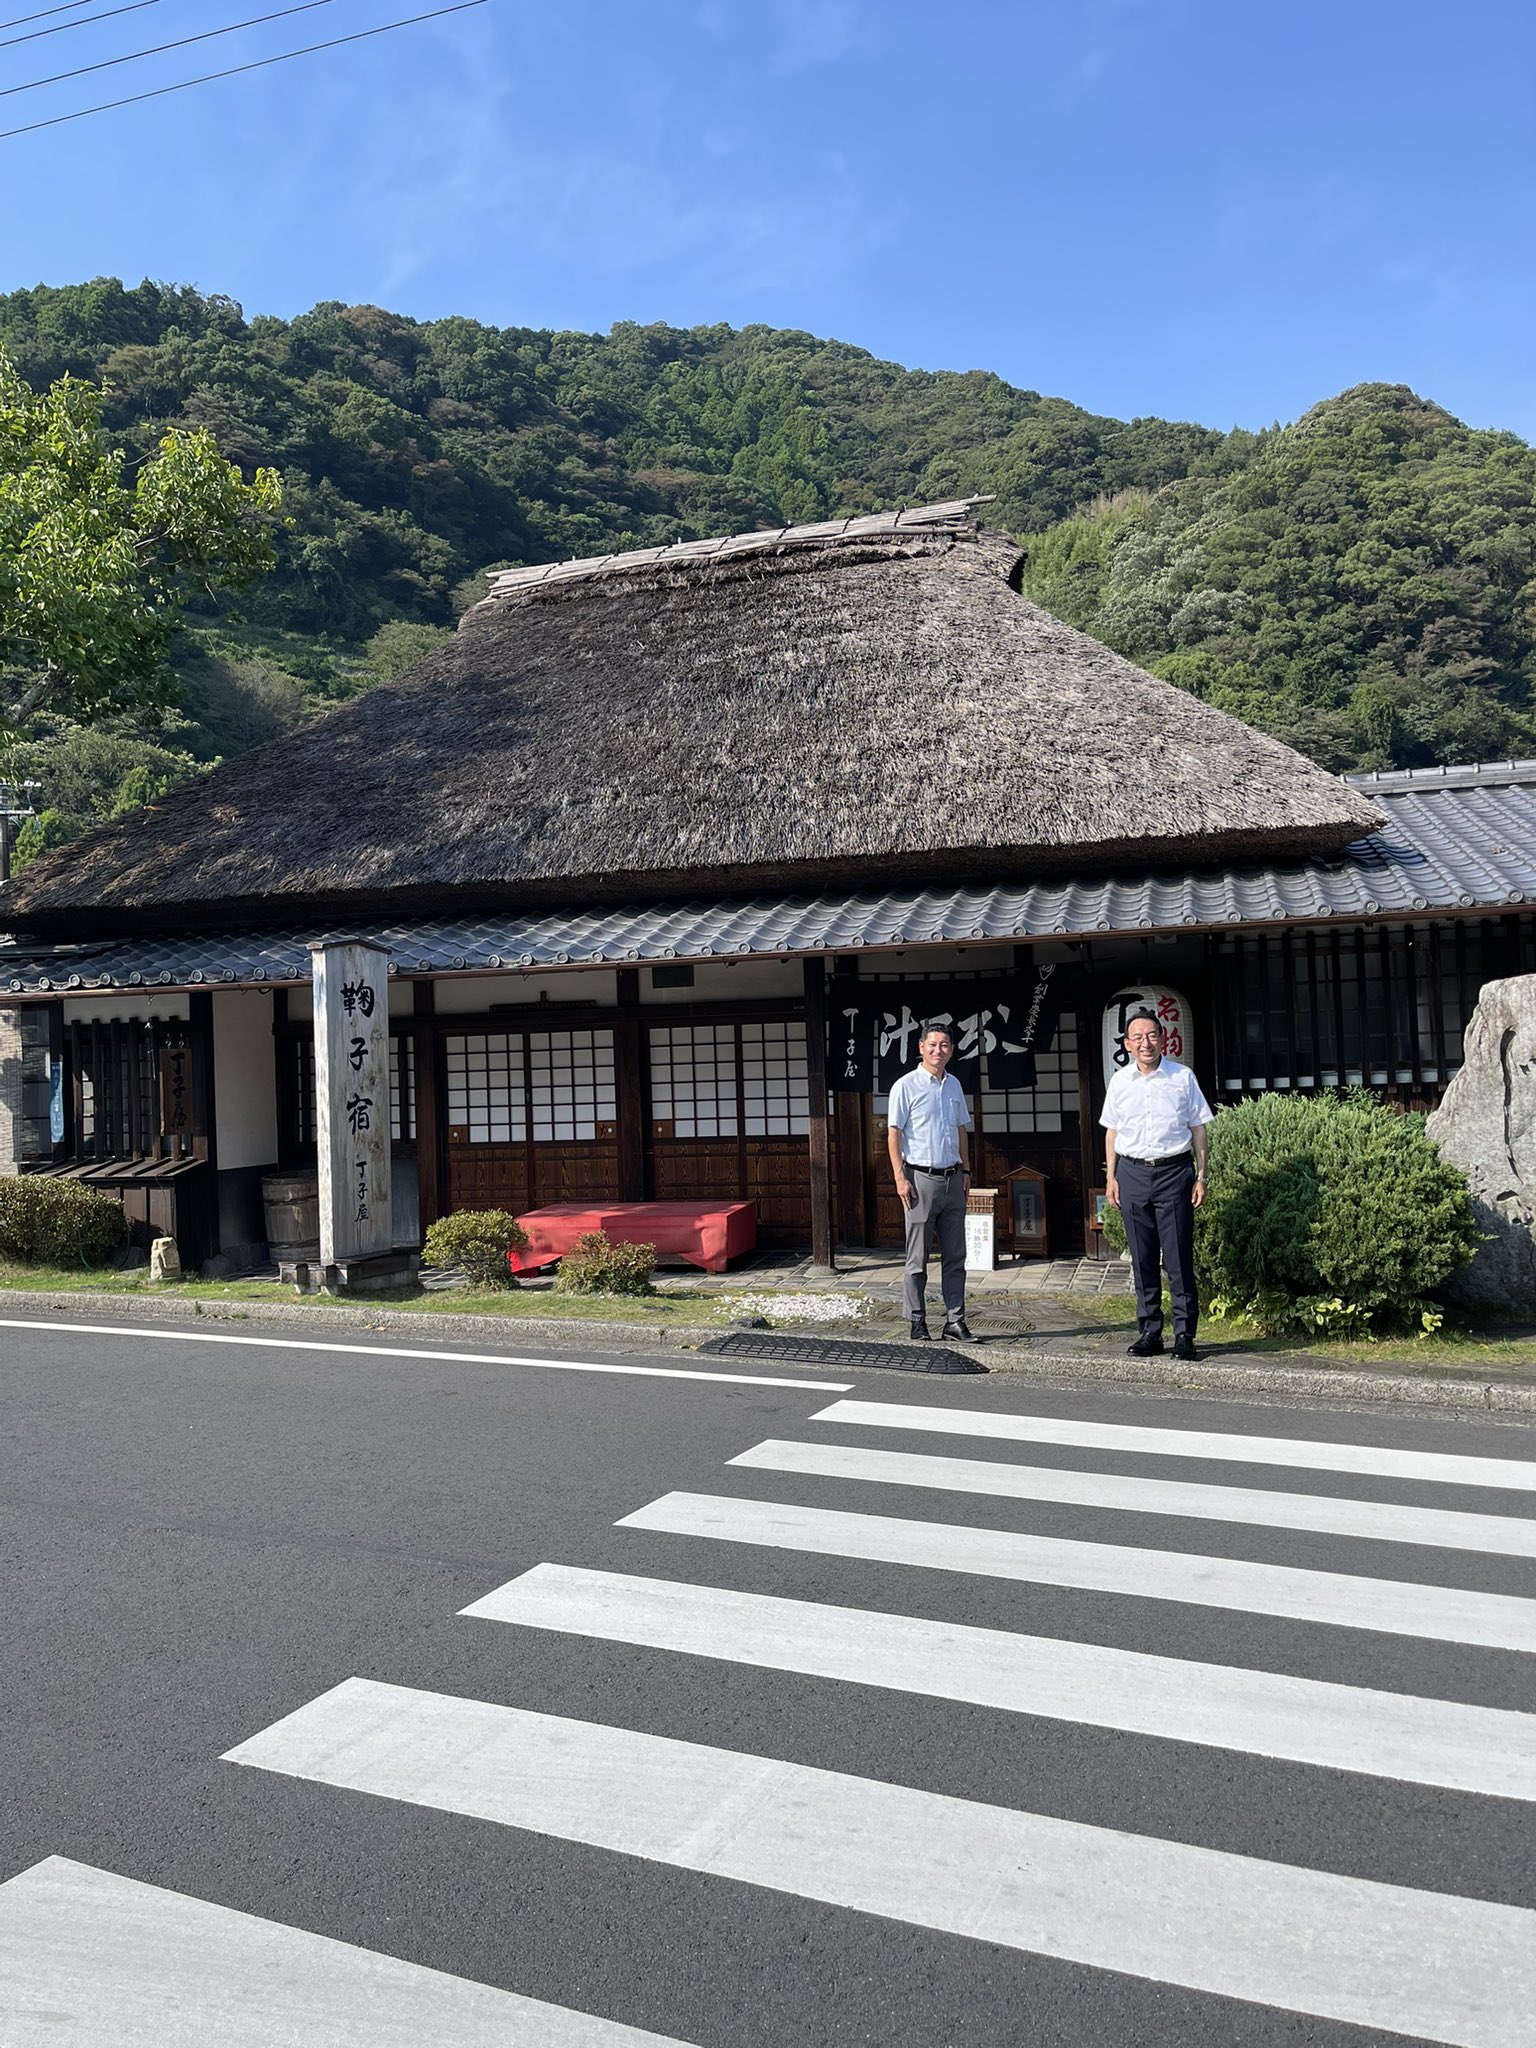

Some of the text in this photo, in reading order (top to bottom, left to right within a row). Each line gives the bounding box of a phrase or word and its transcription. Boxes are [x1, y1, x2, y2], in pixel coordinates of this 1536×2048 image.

[339, 978, 375, 1135] 鞠子宿
[842, 1008, 859, 1078] 丁子屋
[1157, 995, 1183, 1058] 名物
[170, 1052, 187, 1130] 丁子屋
[354, 1160, 369, 1222] 丁子屋
[1022, 1198, 1034, 1231] 丁子屋
